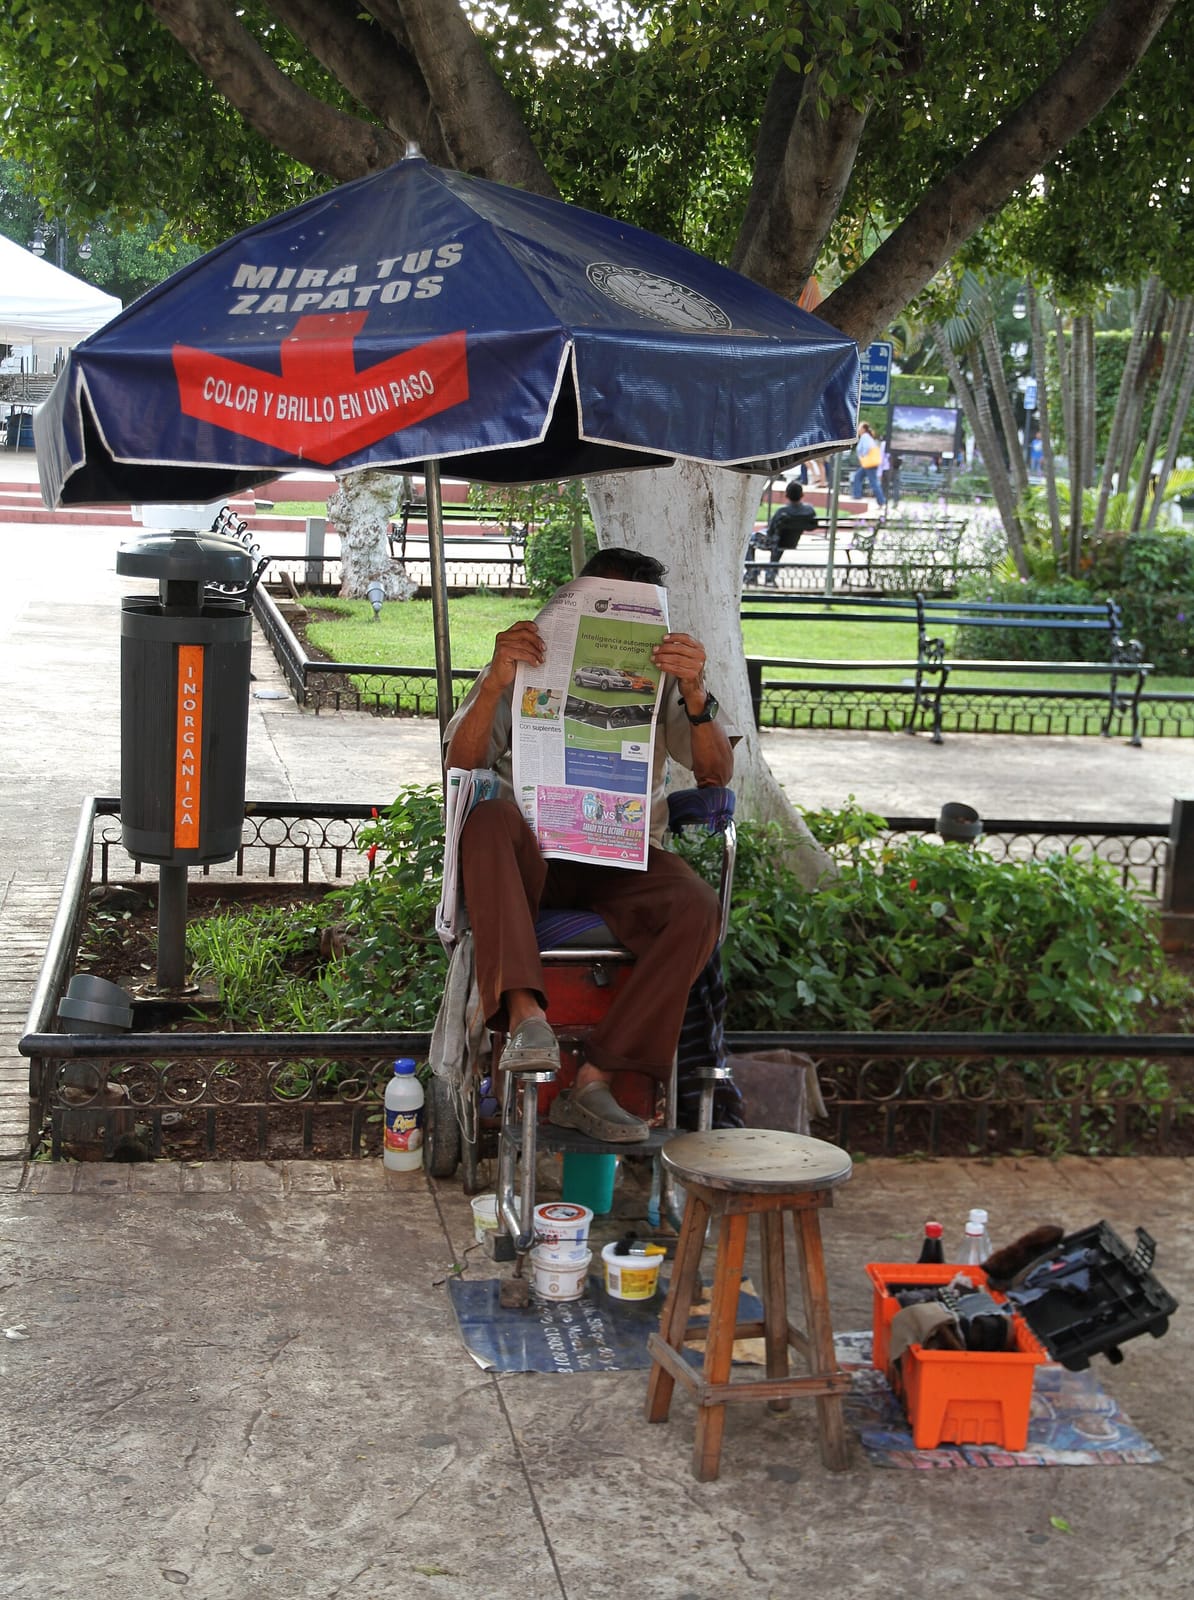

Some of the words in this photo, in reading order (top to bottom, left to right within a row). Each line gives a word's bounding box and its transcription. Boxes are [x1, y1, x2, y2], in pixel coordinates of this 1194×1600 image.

[231, 263, 359, 289] MIRA
[376, 242, 464, 279] TUS
[227, 275, 445, 315] ZAPATOS
[202, 376, 259, 414] COLOR
[263, 391, 274, 417] Y
[276, 394, 336, 423] BRILLO
[340, 392, 363, 421] EN
[366, 386, 390, 416] UN
[390, 369, 436, 408] PASO
[581, 633, 622, 645] Inteligencia
[180, 666, 197, 825] INORGANICA
